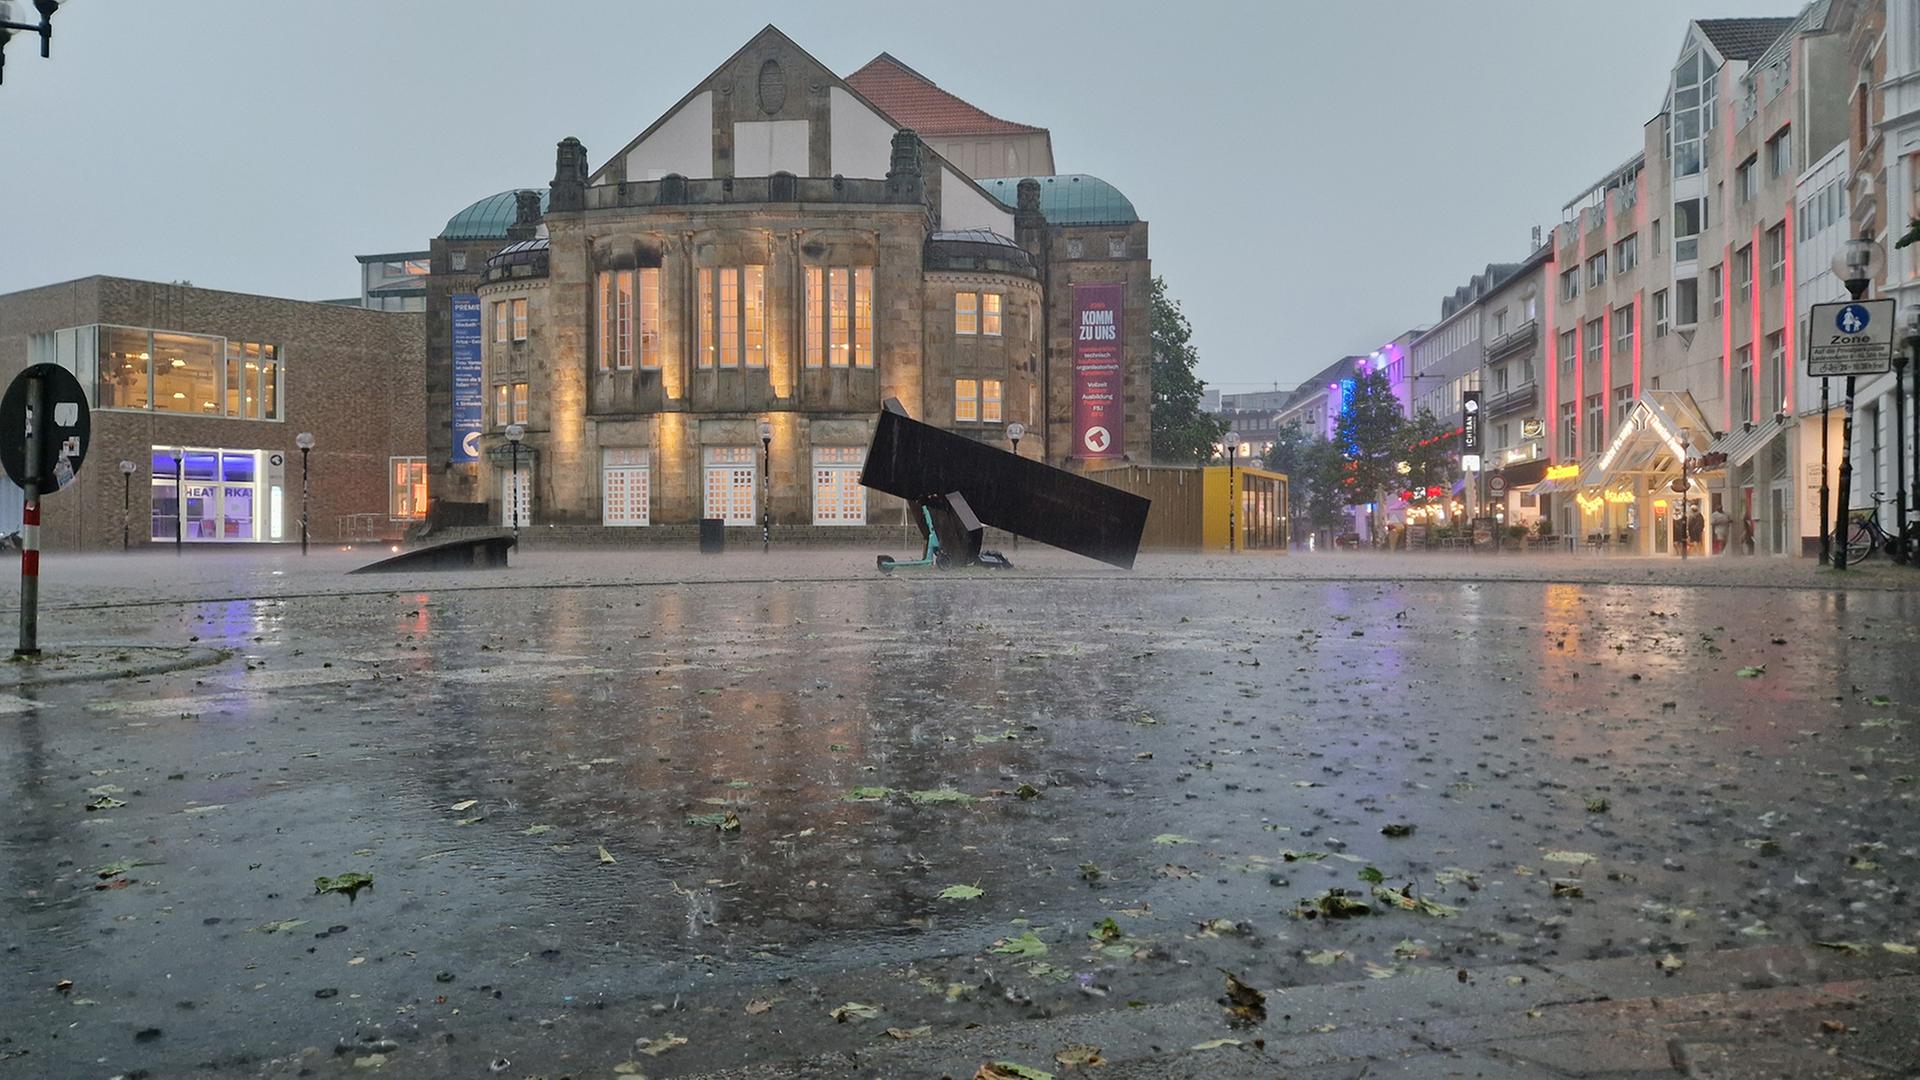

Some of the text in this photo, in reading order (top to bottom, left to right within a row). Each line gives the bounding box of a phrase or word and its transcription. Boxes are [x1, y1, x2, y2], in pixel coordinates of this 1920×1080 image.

[1082, 310, 1114, 325] KOMM
[1079, 325, 1116, 340] ZU UNS
[1830, 335, 1871, 345] Zone
[1465, 415, 1473, 447] ICHIBAN
